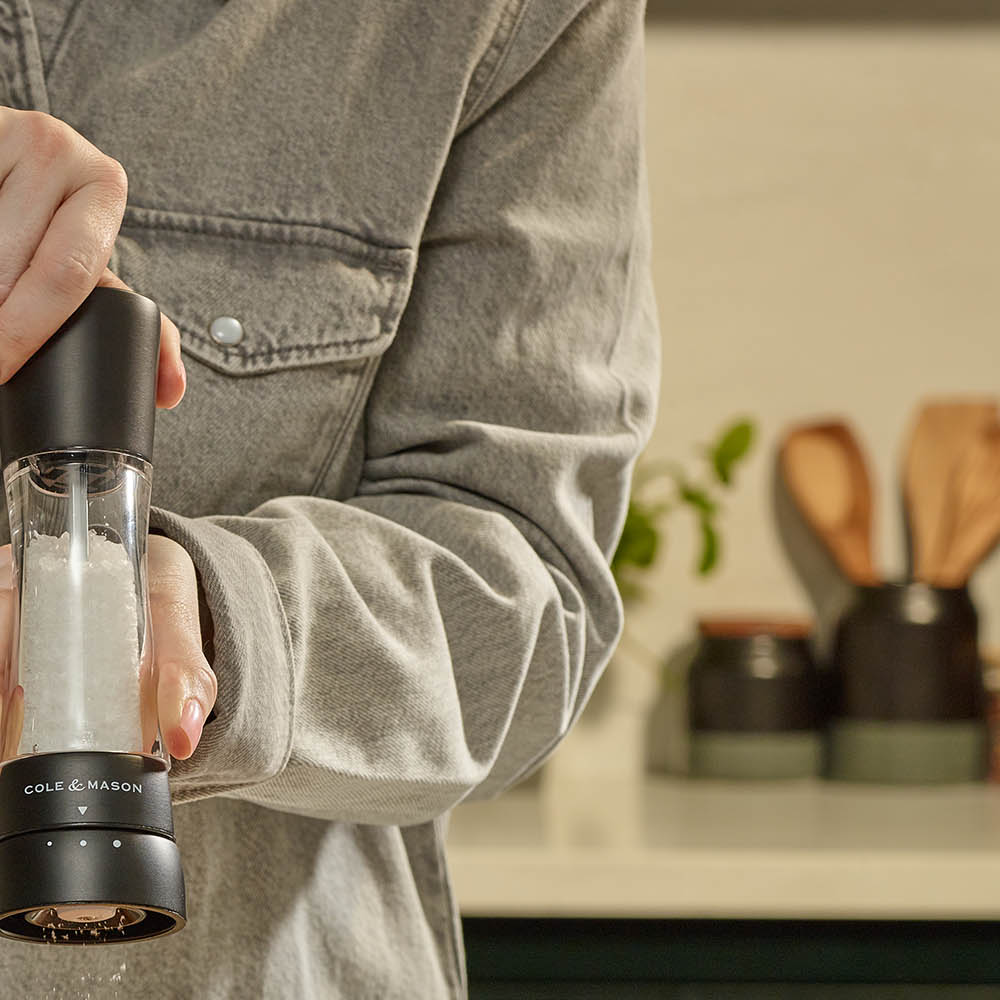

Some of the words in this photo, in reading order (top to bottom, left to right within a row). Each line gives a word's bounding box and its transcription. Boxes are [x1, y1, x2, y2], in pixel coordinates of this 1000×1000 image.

[24, 781, 65, 795] COLE
[68, 778, 86, 792] &
[87, 780, 143, 794] MASON
